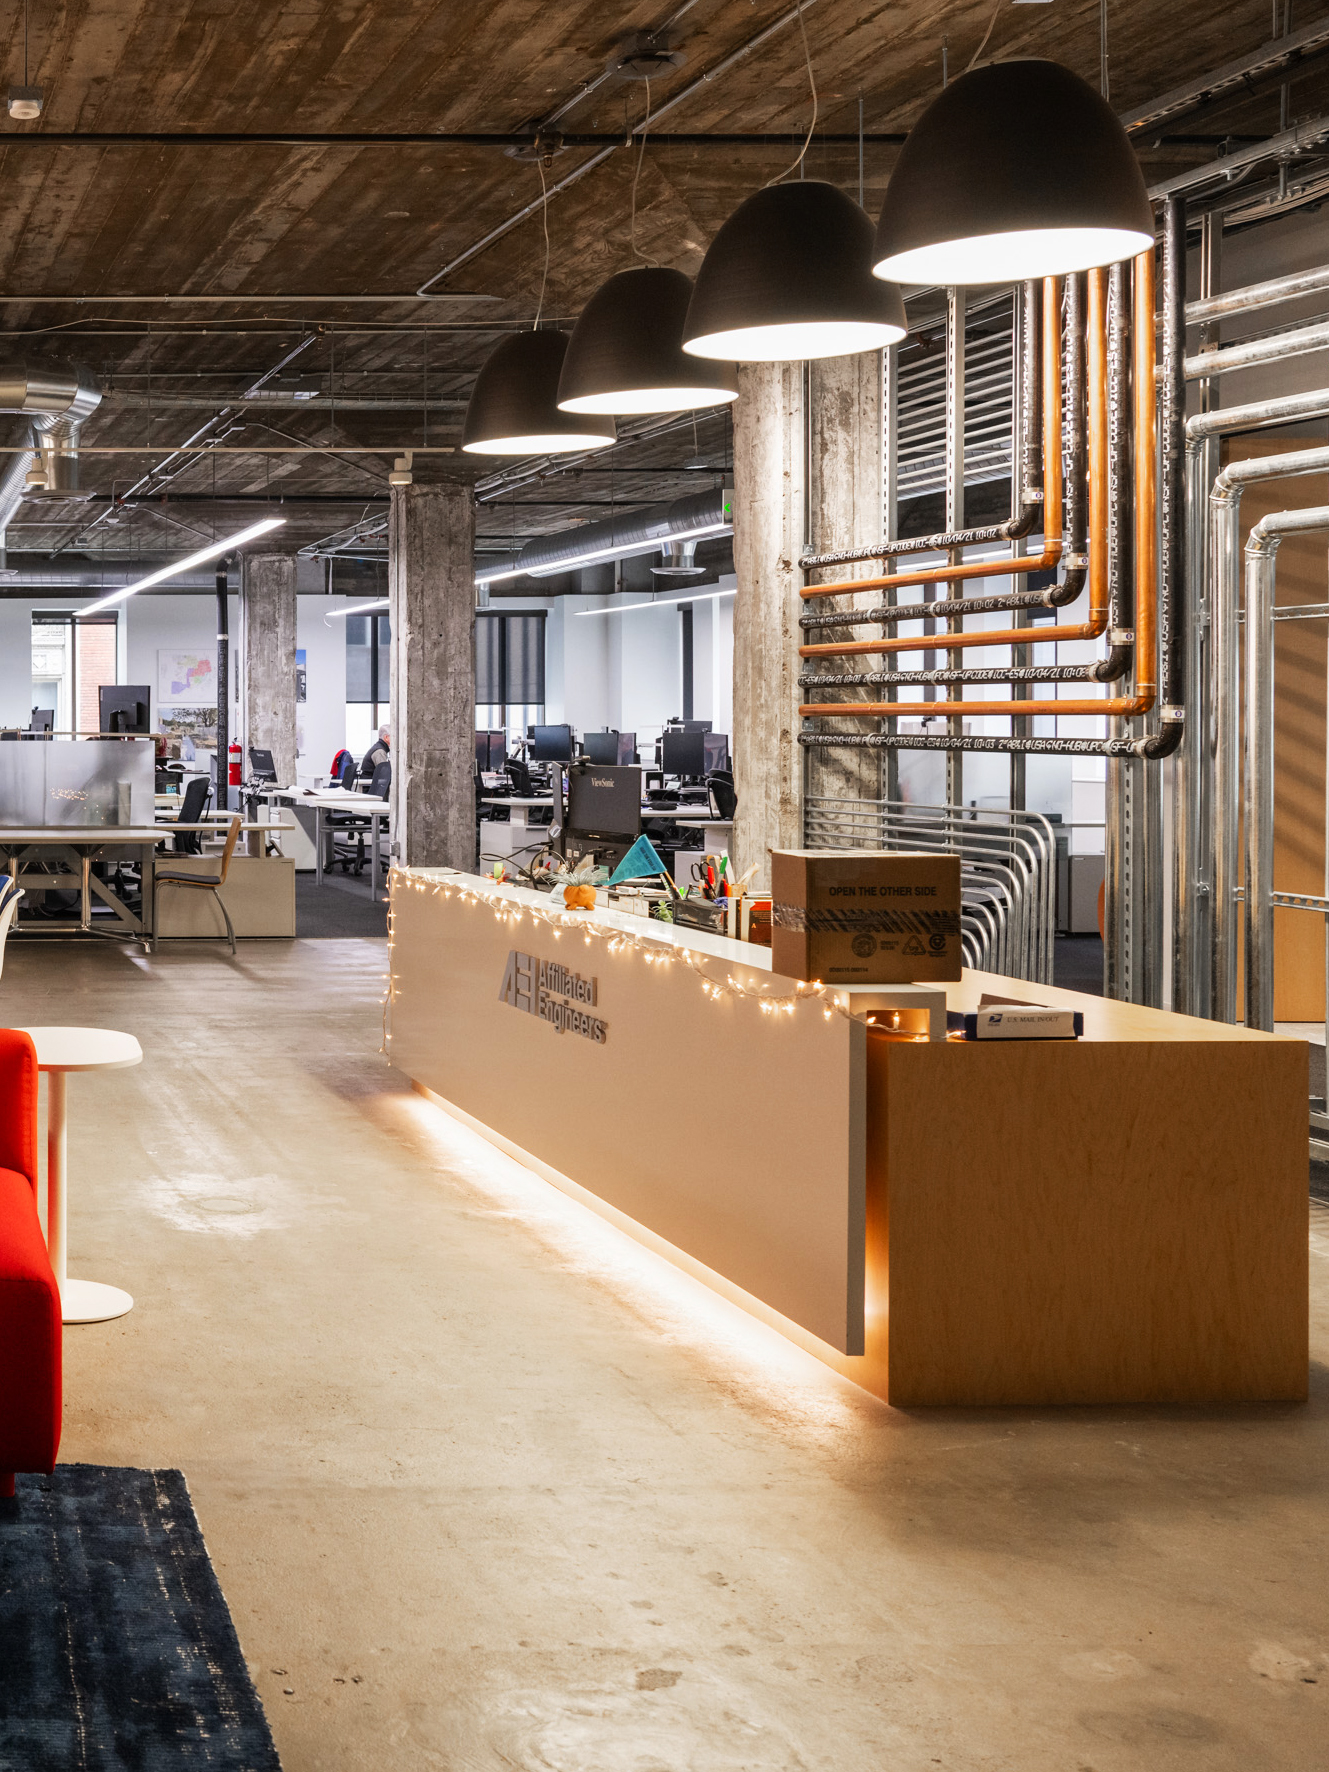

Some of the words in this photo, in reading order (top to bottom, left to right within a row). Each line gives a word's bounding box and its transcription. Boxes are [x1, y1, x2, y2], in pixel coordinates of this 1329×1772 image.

[591, 777, 615, 788] ViewSonic
[829, 886, 856, 897] OPEN
[858, 886, 877, 896] THE
[879, 886, 912, 896] OTHER
[914, 886, 937, 896] SIDE
[538, 960, 598, 1008] Affiliated
[538, 990, 607, 1045] Engineers
